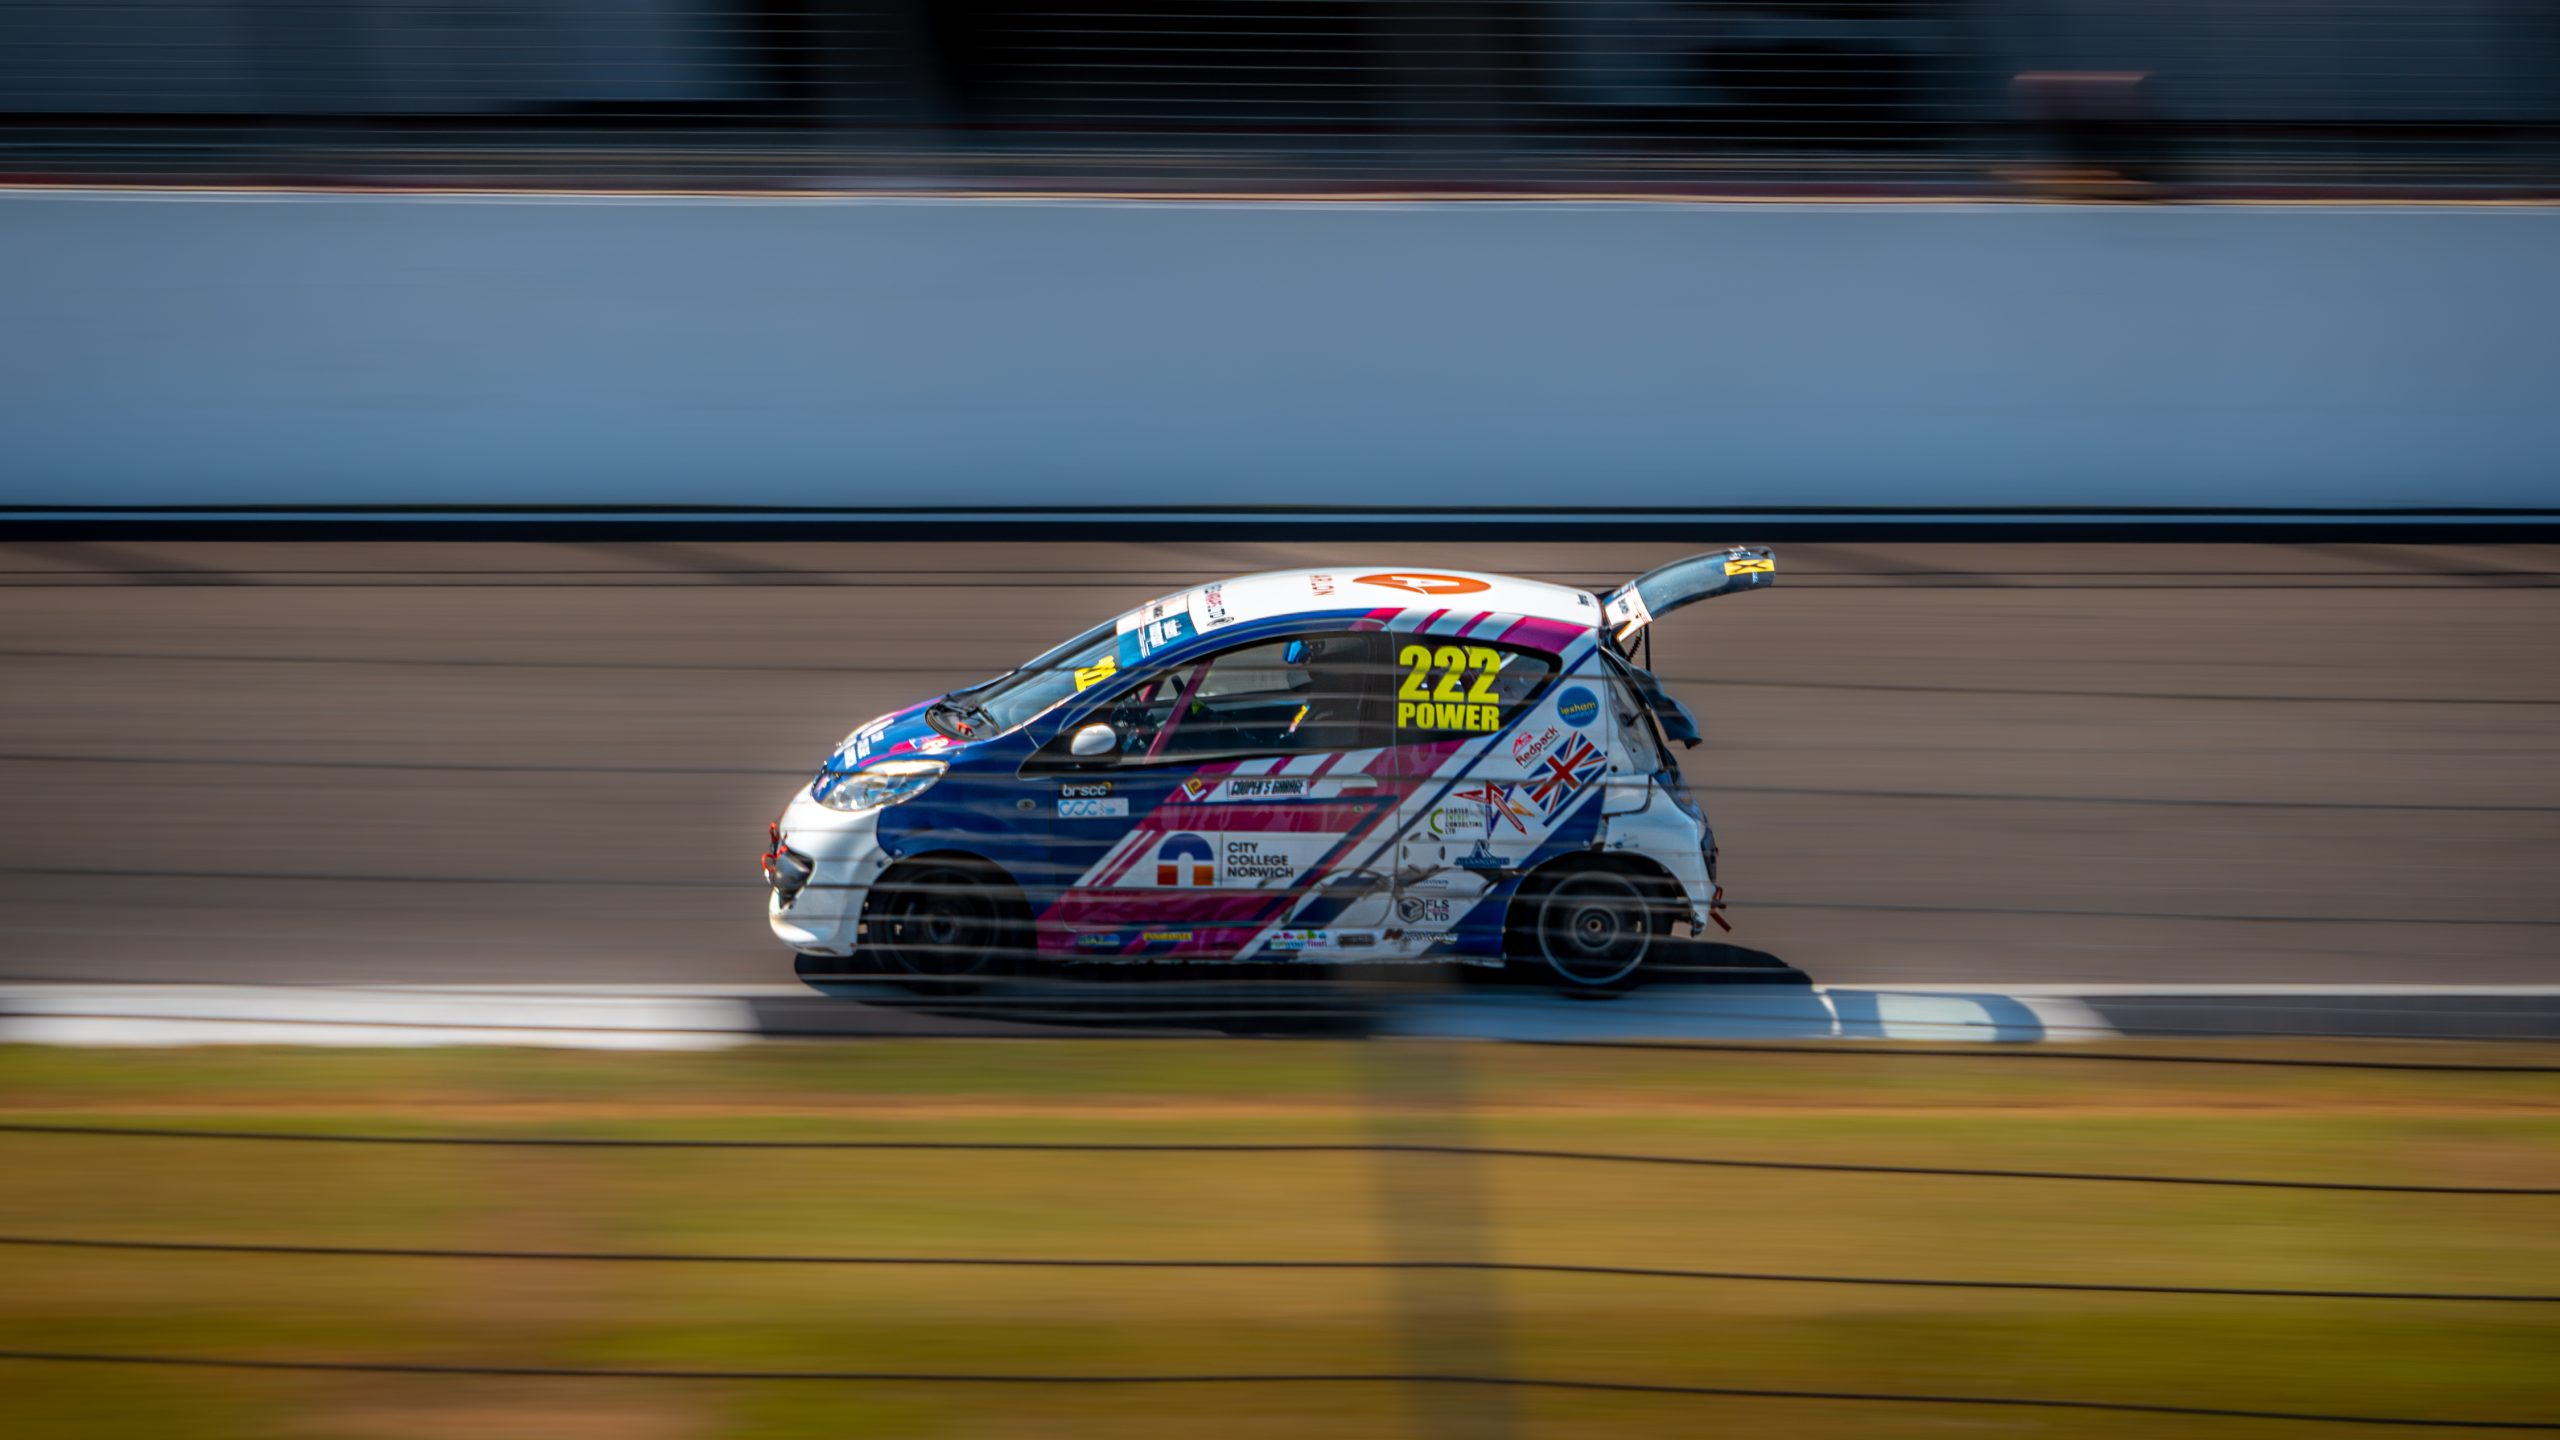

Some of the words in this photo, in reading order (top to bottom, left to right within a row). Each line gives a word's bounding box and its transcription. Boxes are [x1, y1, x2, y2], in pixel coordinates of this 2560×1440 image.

[1399, 645, 1501, 704] 222
[1397, 702, 1500, 731] POWER
[1515, 725, 1558, 766] Redpack
[1062, 784, 1107, 797] brscc
[1227, 842, 1258, 853] CITY
[1227, 855, 1289, 866] COLLEGE
[1227, 867, 1294, 878] NORWICH
[1425, 912, 1449, 922] LTD
